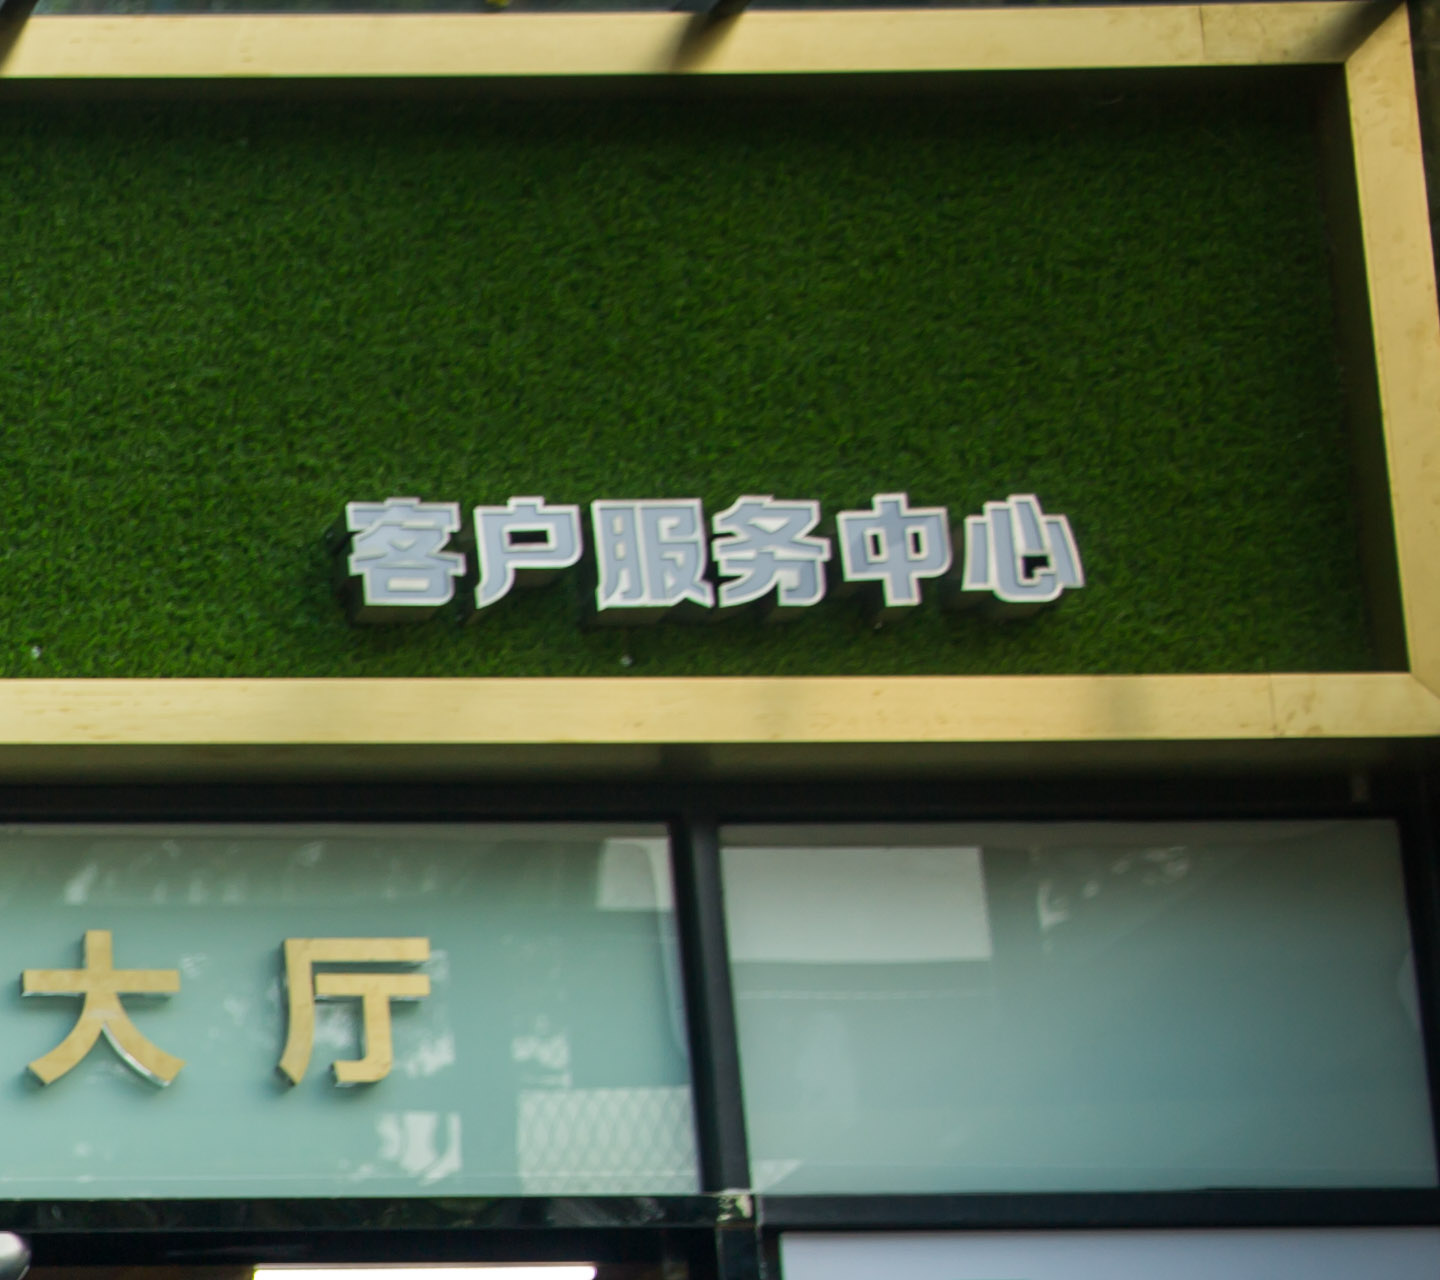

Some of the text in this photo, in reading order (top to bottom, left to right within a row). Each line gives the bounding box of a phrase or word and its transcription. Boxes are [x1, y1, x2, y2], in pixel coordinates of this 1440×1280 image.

[346, 494, 1084, 610] 客户服务中心
